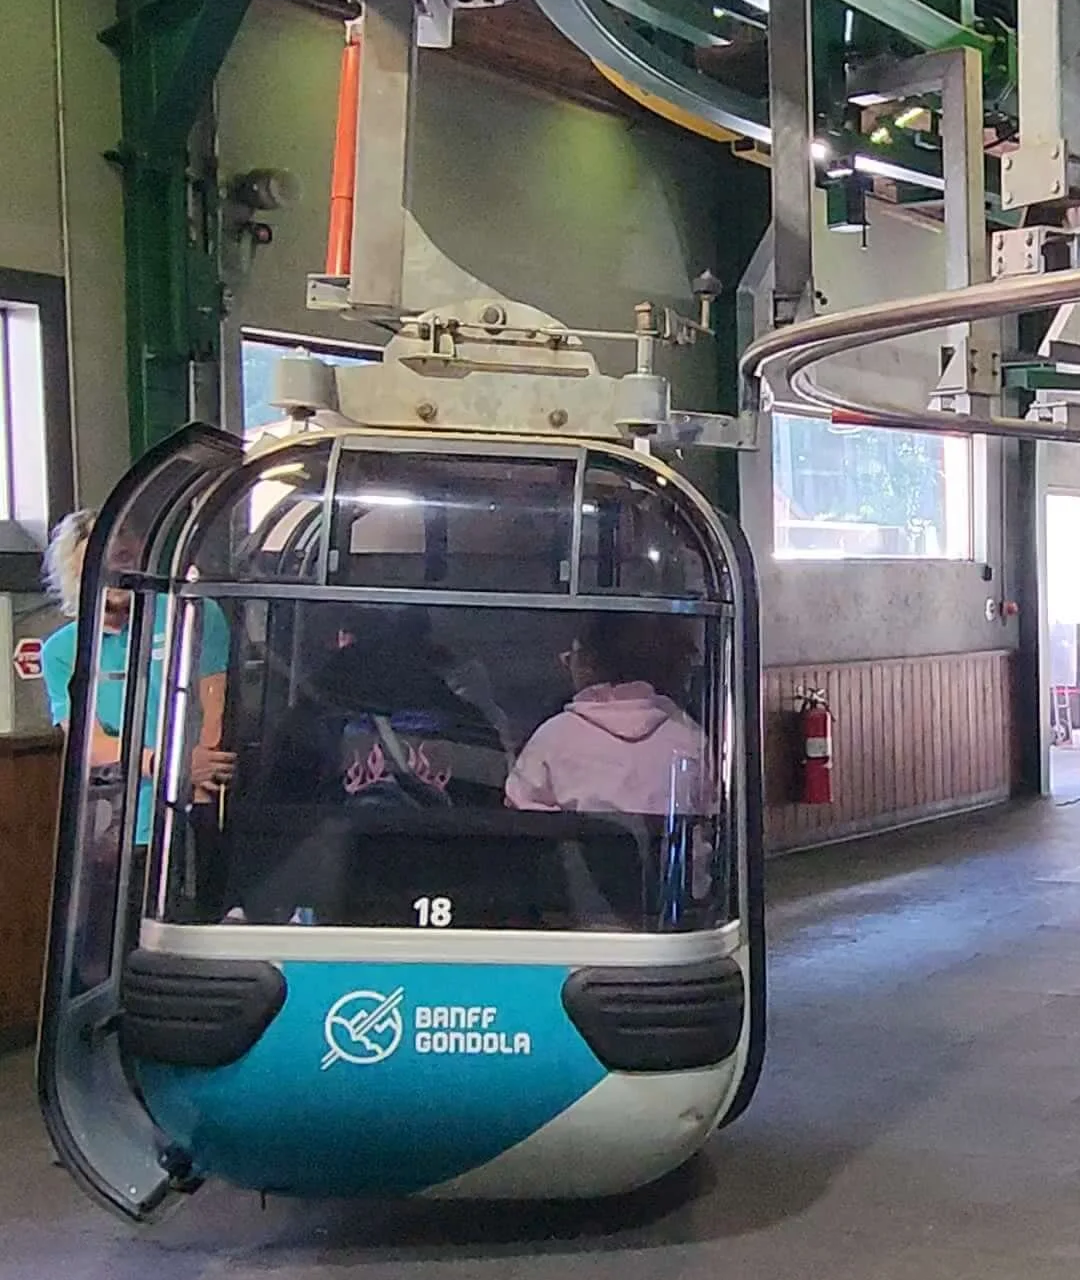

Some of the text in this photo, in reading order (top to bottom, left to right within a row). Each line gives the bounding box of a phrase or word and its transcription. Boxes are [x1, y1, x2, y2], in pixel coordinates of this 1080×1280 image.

[413, 897, 452, 927] 18
[415, 1006, 497, 1029] BANFF
[415, 1031, 531, 1055] GONDOLA
